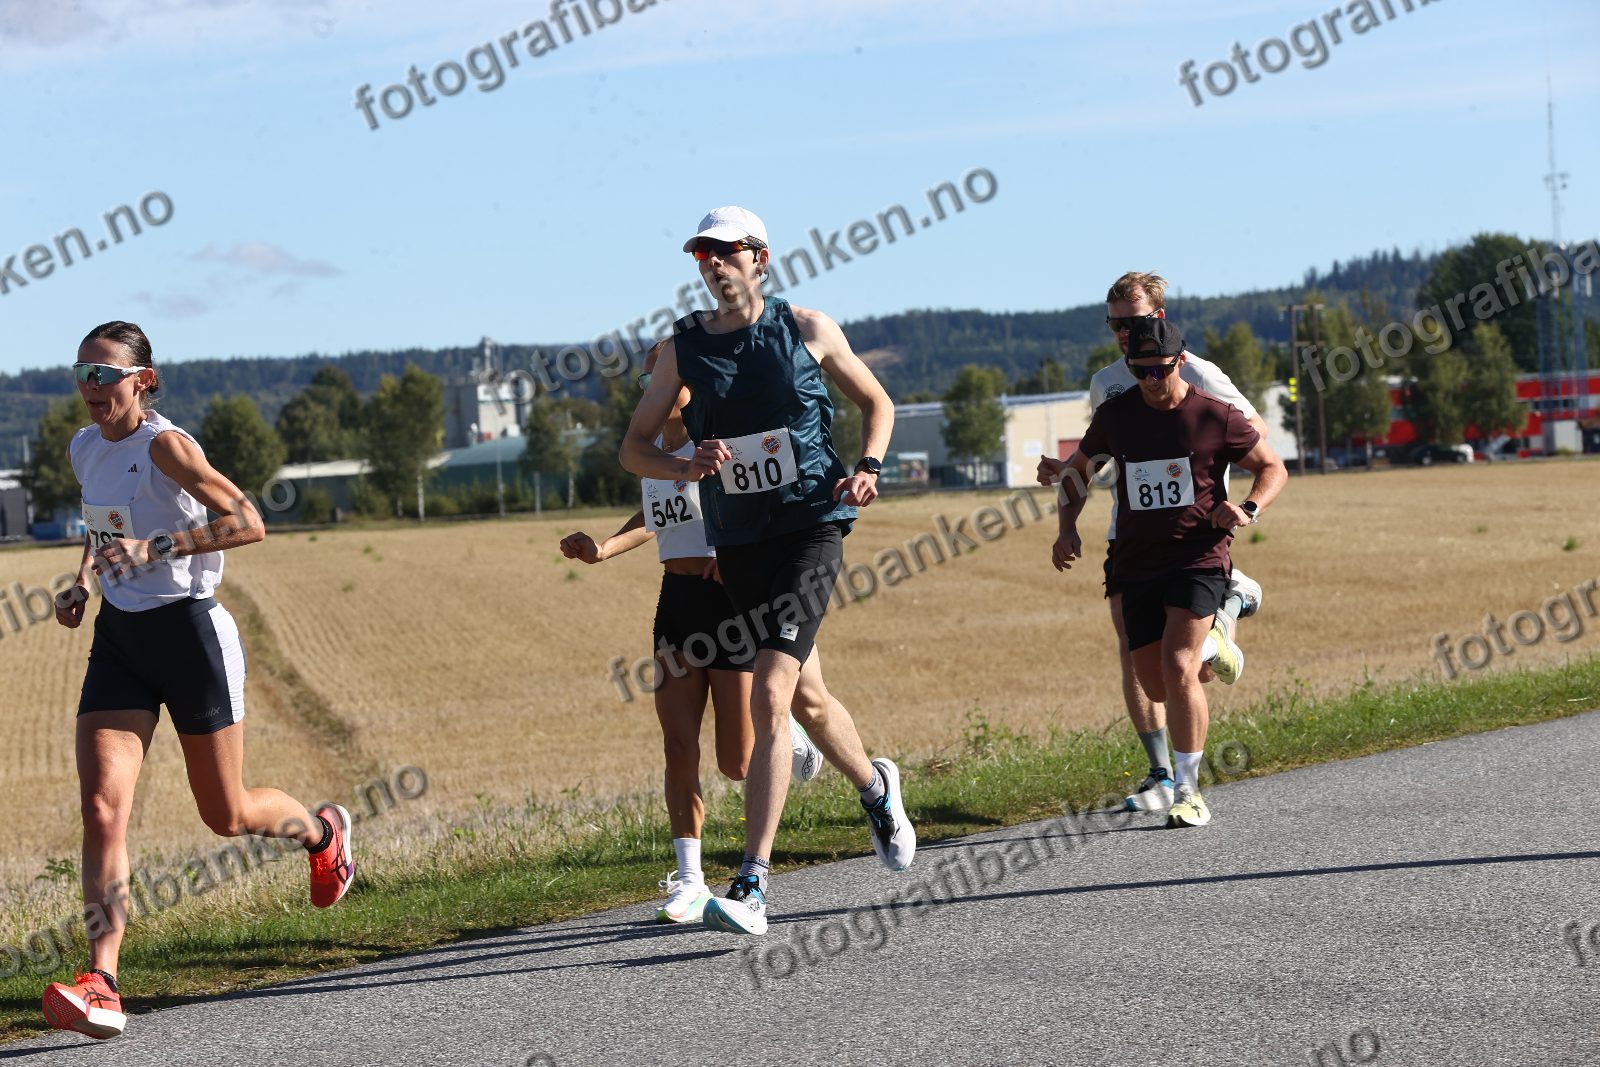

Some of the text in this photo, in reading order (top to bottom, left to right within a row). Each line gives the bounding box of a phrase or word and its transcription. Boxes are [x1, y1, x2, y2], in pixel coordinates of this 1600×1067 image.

[732, 457, 783, 491] 810
[1138, 480, 1182, 508] 813
[652, 495, 693, 528] 542
